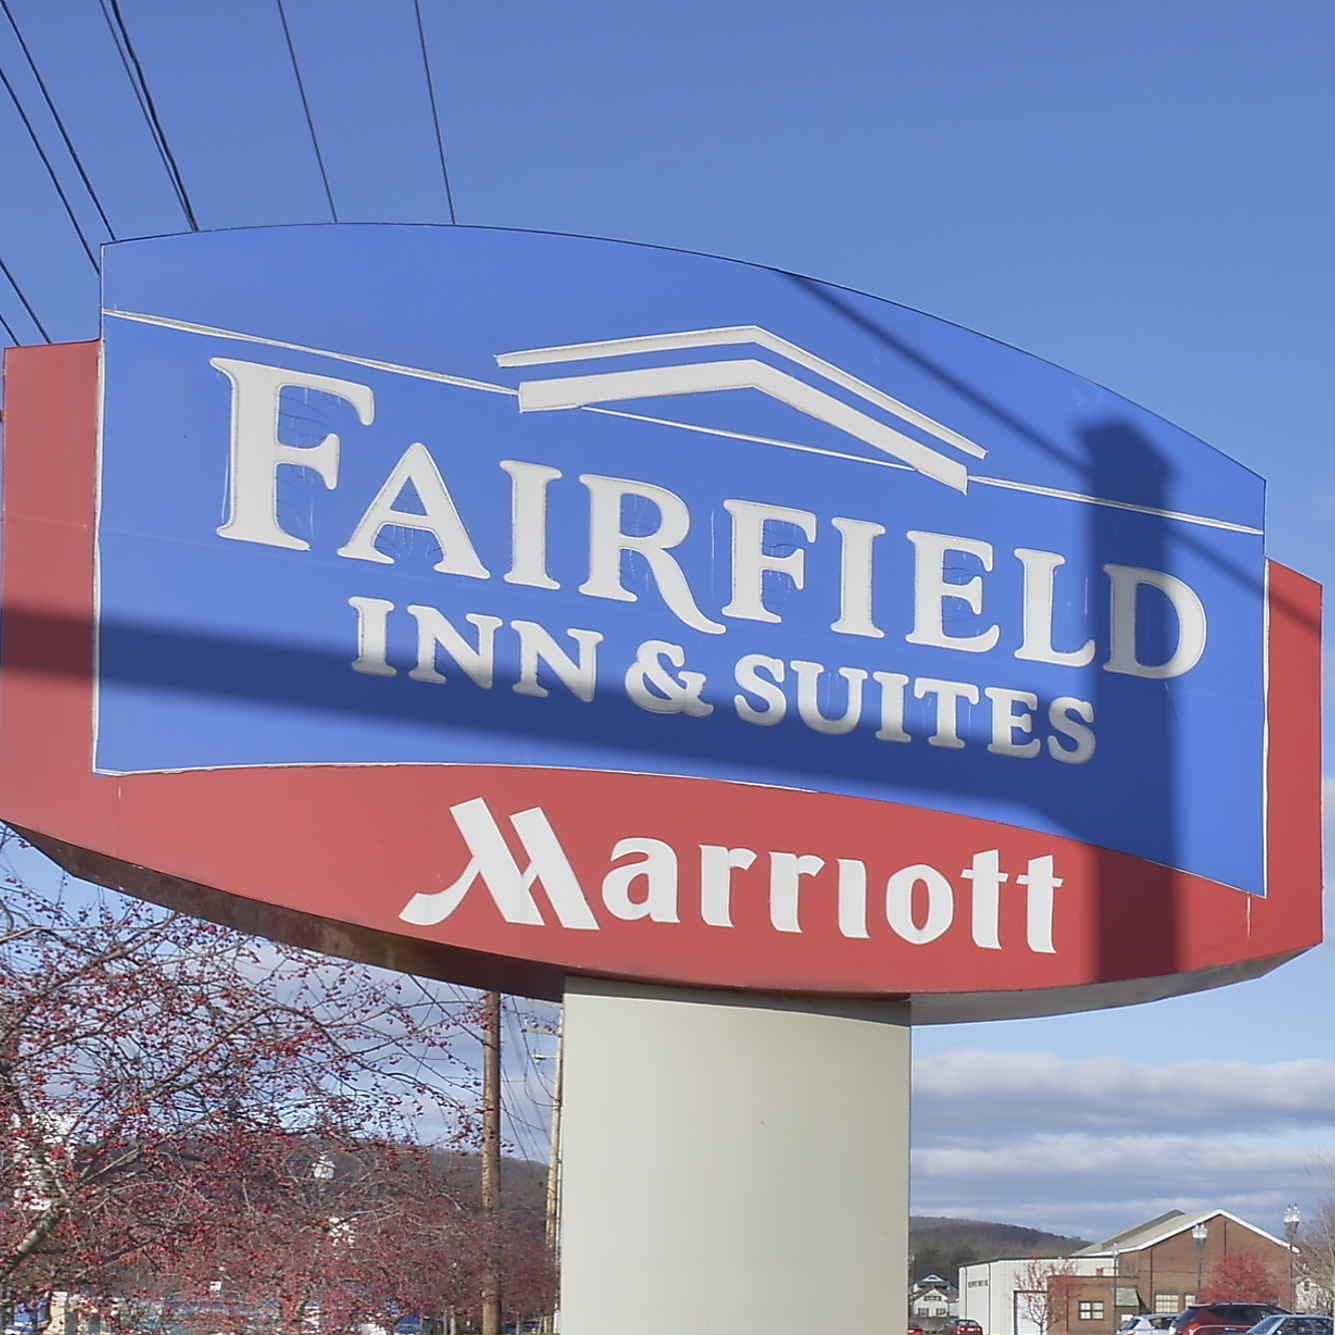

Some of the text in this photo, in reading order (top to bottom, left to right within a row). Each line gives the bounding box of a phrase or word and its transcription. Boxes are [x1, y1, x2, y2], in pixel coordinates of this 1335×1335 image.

[208, 356, 1208, 680] FAIRFIELD
[346, 595, 1097, 765] INN & SUITES
[398, 796, 1064, 954] Marriott
